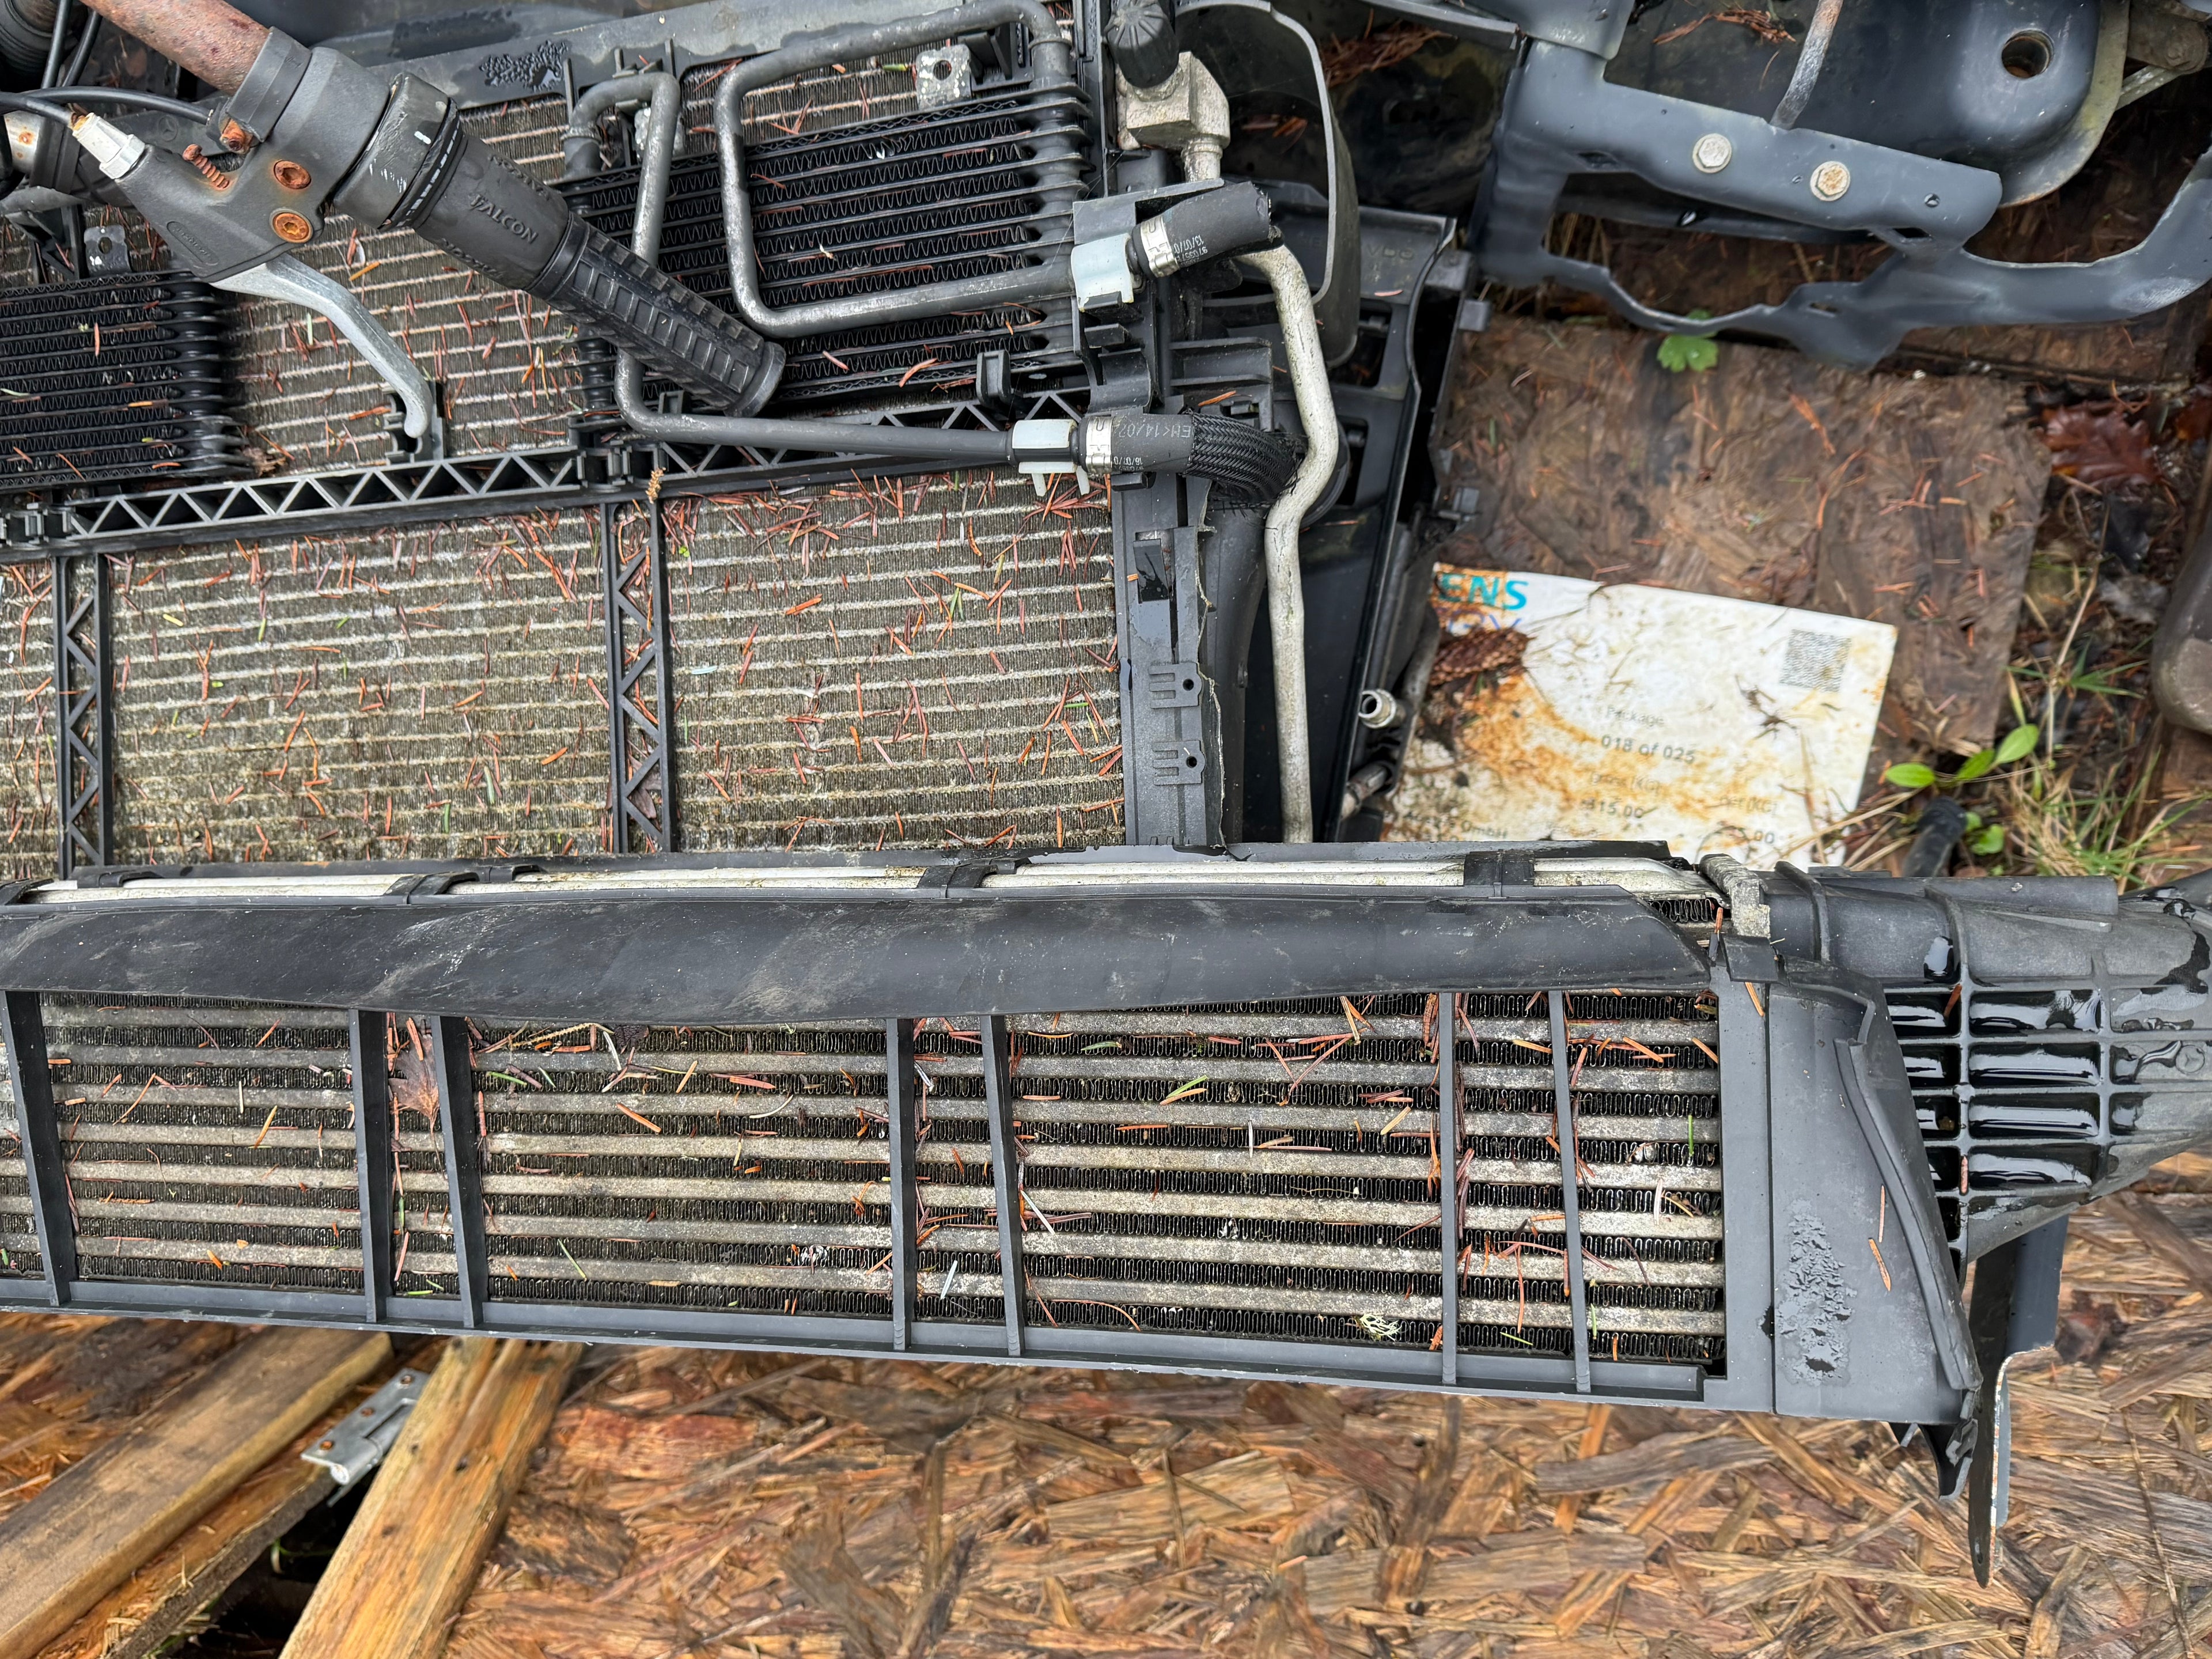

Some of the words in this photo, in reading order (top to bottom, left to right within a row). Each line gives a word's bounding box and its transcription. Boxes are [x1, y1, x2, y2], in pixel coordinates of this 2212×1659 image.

[469, 194, 539, 244] FALCON
[1601, 734, 1634, 753] 018
[1638, 742, 1659, 756] of
[1662, 745, 1696, 765] 025
